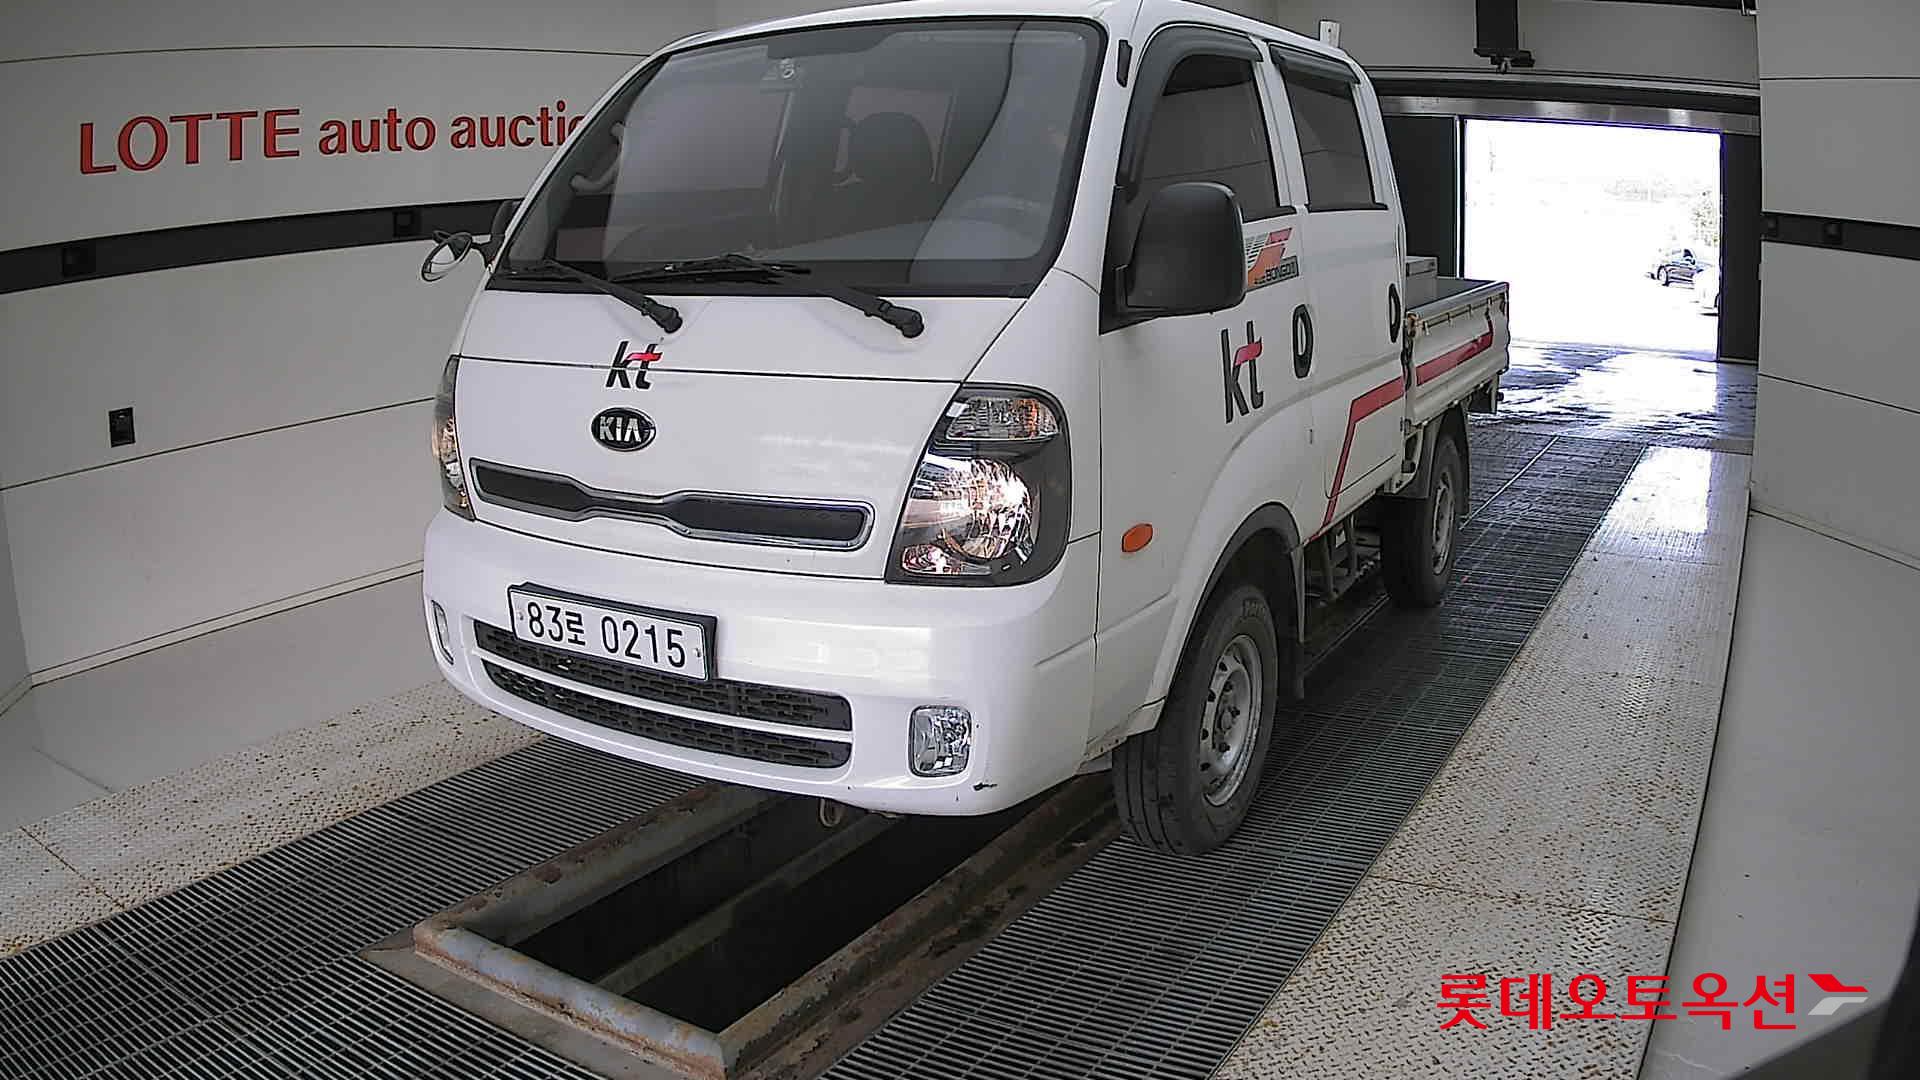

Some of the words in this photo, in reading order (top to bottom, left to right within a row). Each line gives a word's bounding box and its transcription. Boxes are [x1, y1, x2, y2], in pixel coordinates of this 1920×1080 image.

[80, 108, 300, 175] LOTTE
[318, 107, 437, 155] auto
[607, 341, 663, 388] kt
[1220, 320, 1263, 424] kt
[599, 416, 642, 442] KIA
[527, 601, 586, 646] 83로
[601, 615, 686, 668] 0215
